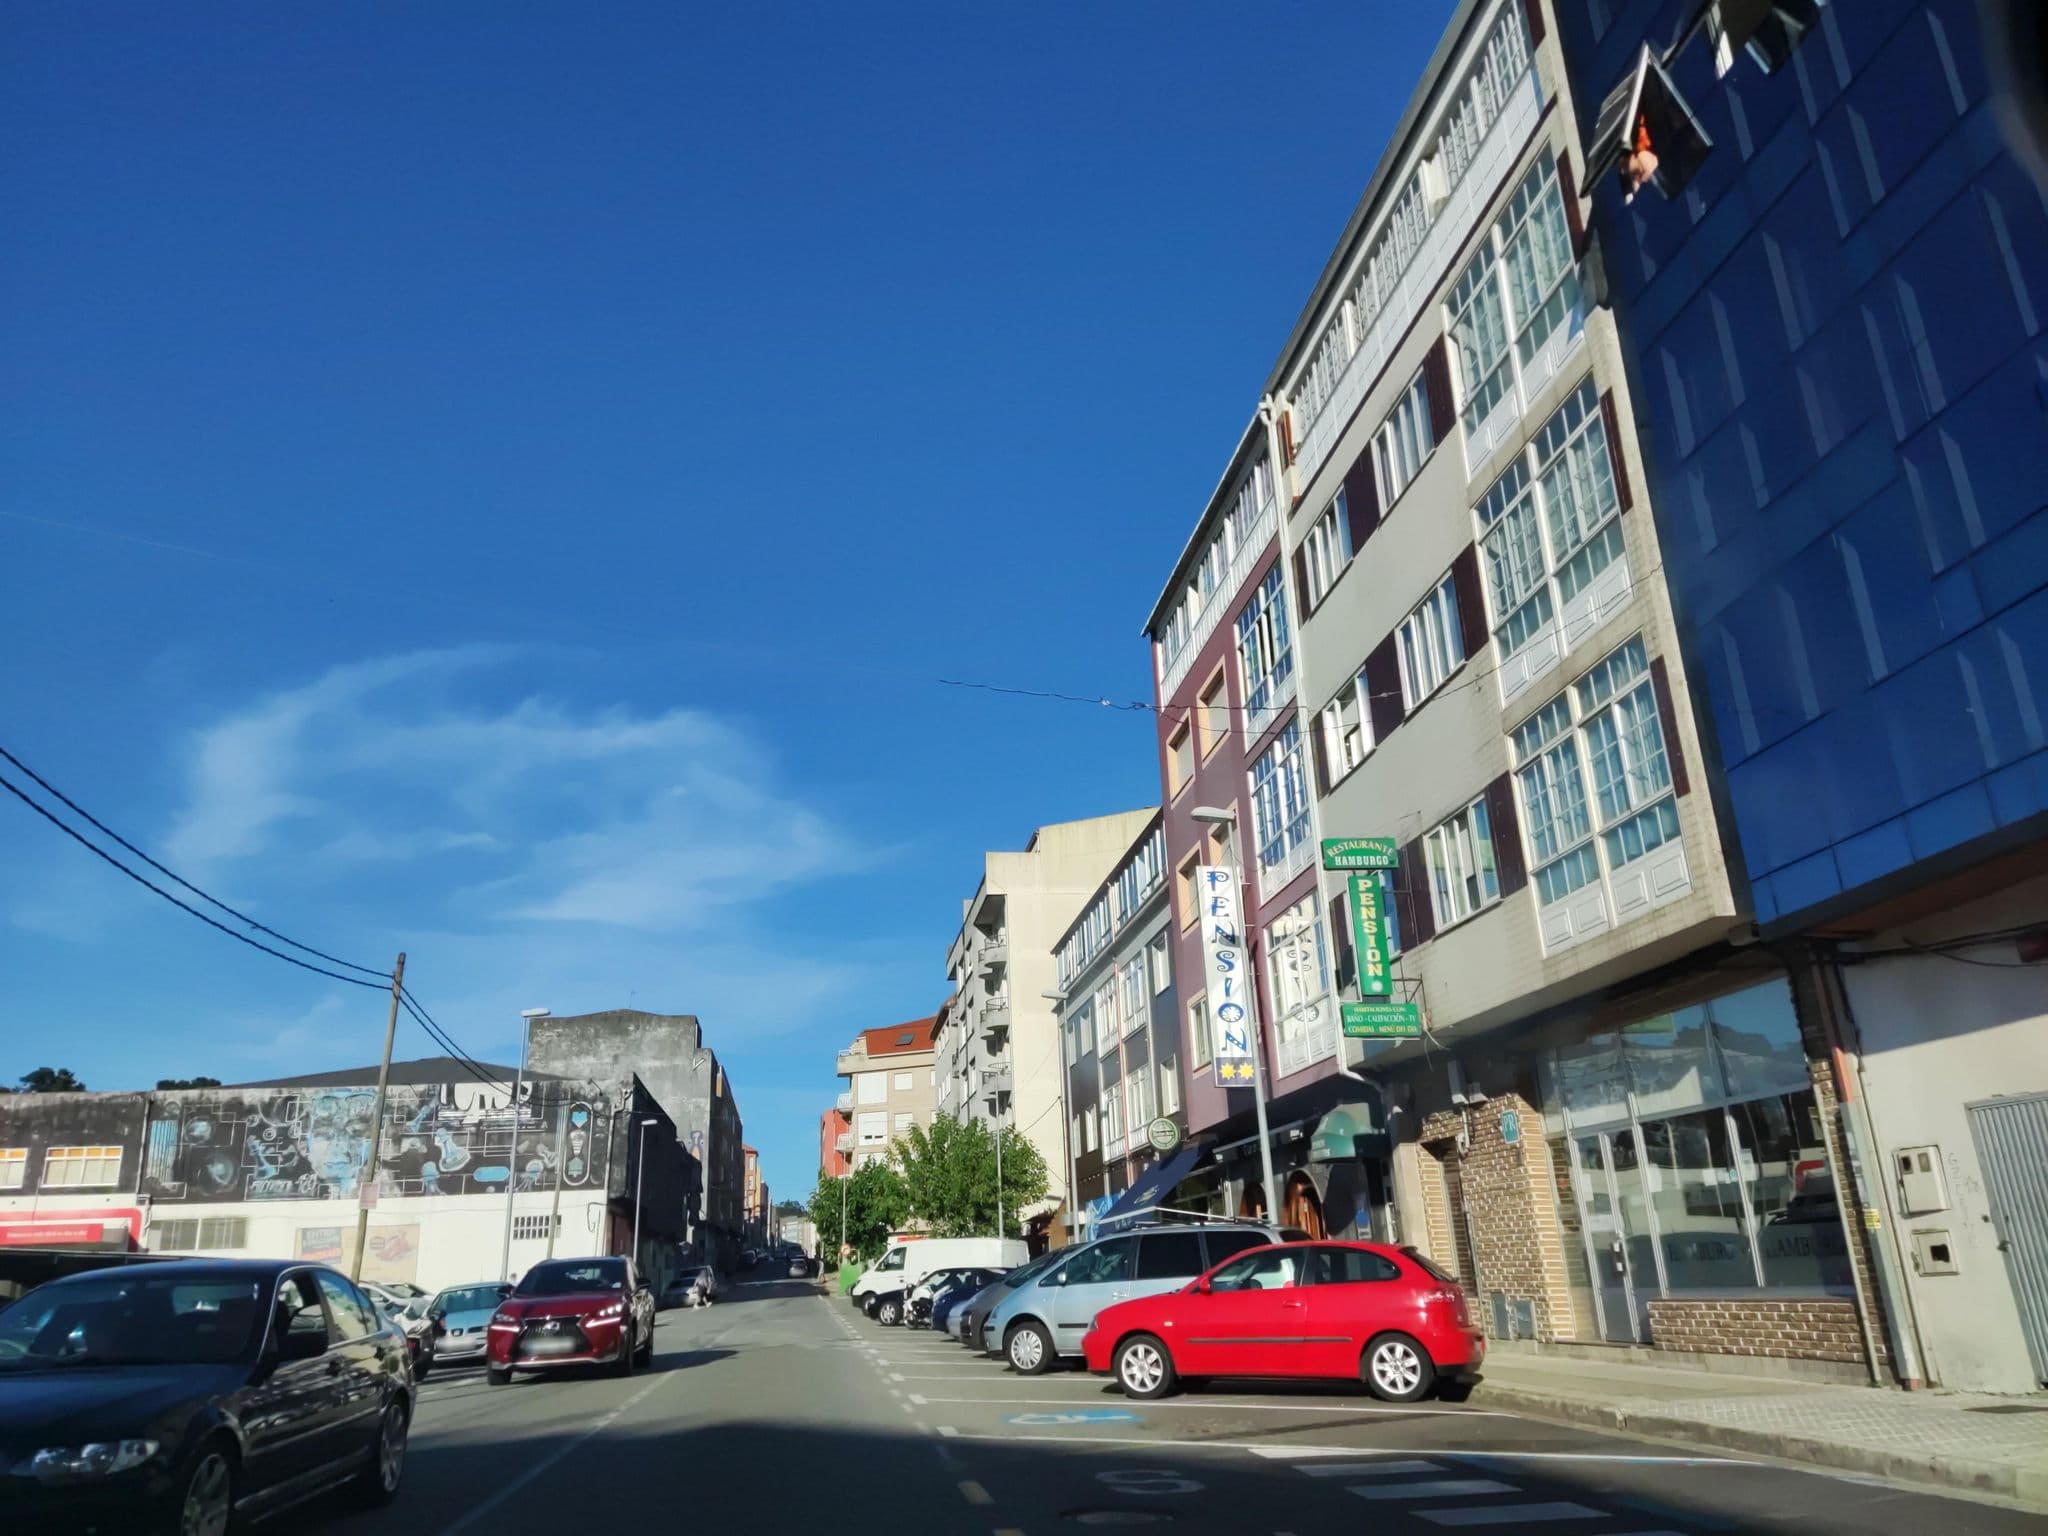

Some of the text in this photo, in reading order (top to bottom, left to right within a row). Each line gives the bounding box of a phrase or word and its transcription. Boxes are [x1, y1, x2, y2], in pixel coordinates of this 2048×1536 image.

[1327, 840, 1393, 857] RESTAURANTE
[1334, 855, 1389, 866] HAMBURGO
[1357, 879, 1383, 977] PENSION
[1206, 870, 1248, 1053] PENSION
